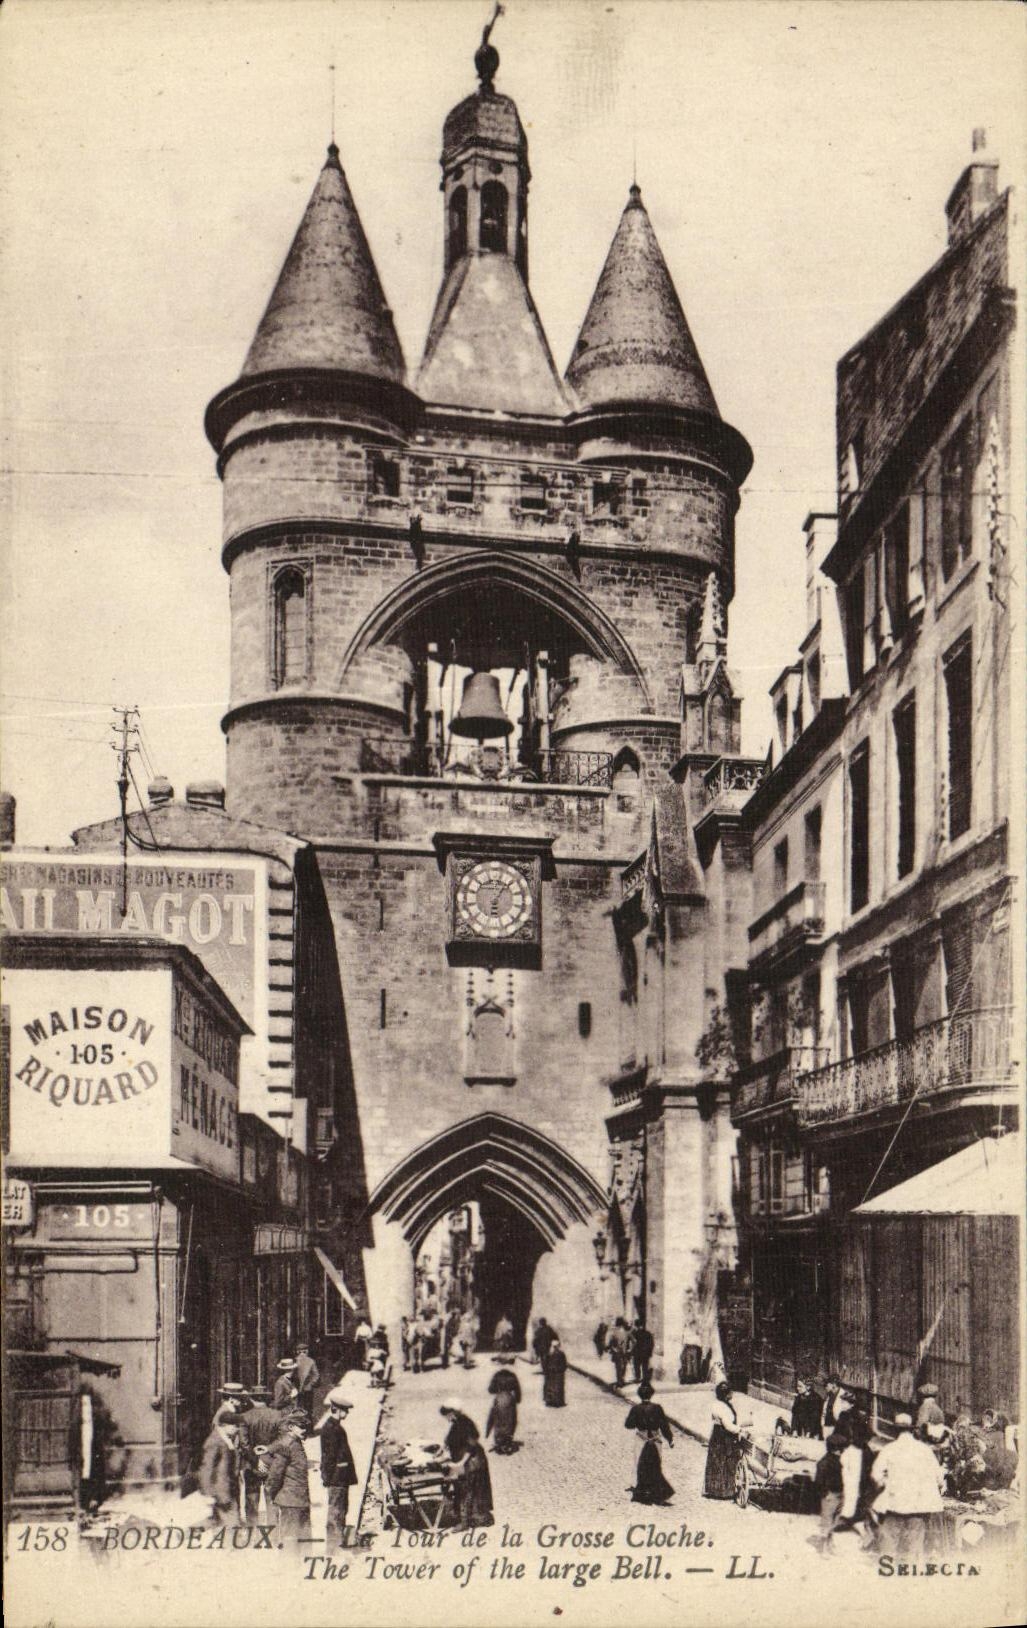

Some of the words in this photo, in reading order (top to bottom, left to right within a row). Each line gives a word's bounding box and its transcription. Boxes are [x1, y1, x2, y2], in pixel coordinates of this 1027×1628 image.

[75, 890, 254, 946] MAGOT
[23, 1005, 155, 1046] MAISON
[15, 1055, 159, 1108] RIQUARD
[74, 1204, 130, 1228] 105
